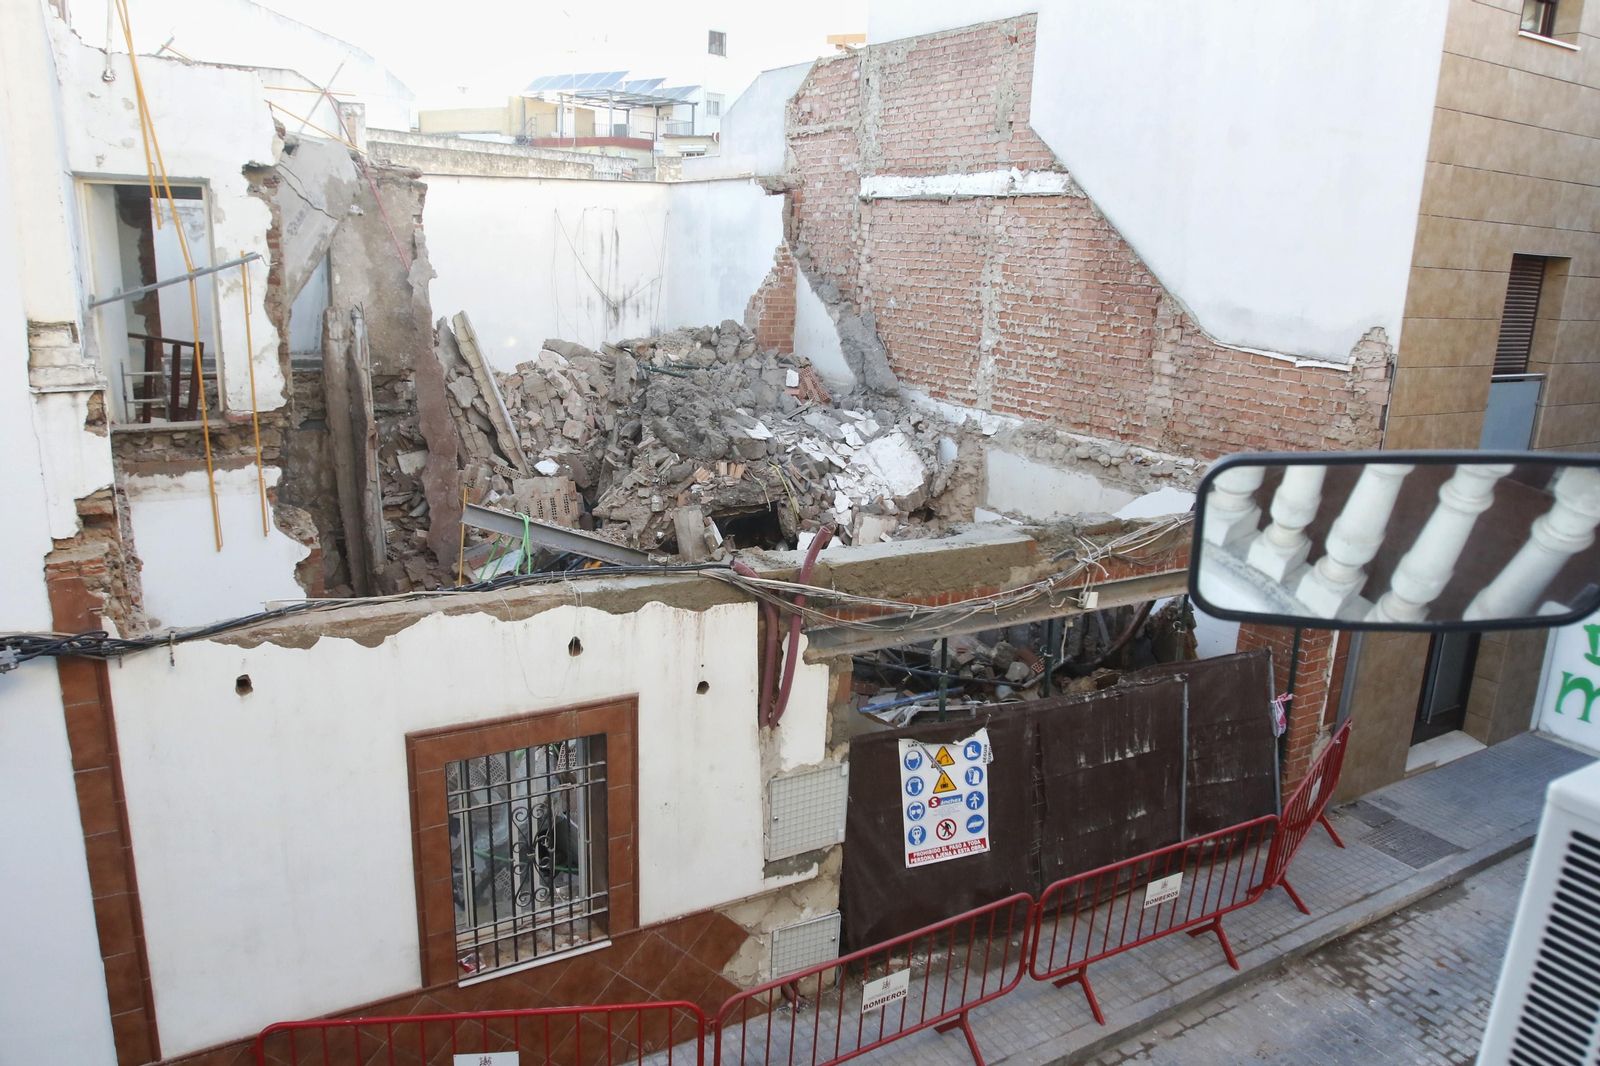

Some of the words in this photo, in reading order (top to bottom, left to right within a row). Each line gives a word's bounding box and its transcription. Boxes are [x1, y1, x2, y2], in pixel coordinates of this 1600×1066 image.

[910, 854, 935, 864] PERSONA
[935, 851, 953, 859] AJENA
[957, 847, 971, 855] ESTA
[971, 844, 985, 852] OBRA
[913, 847, 941, 858] PROHIBIDO
[949, 843, 962, 851] PASO
[967, 839, 981, 847] TODA
[1145, 890, 1179, 906] BOMBEROS
[863, 989, 907, 1010] BOMBEROS
